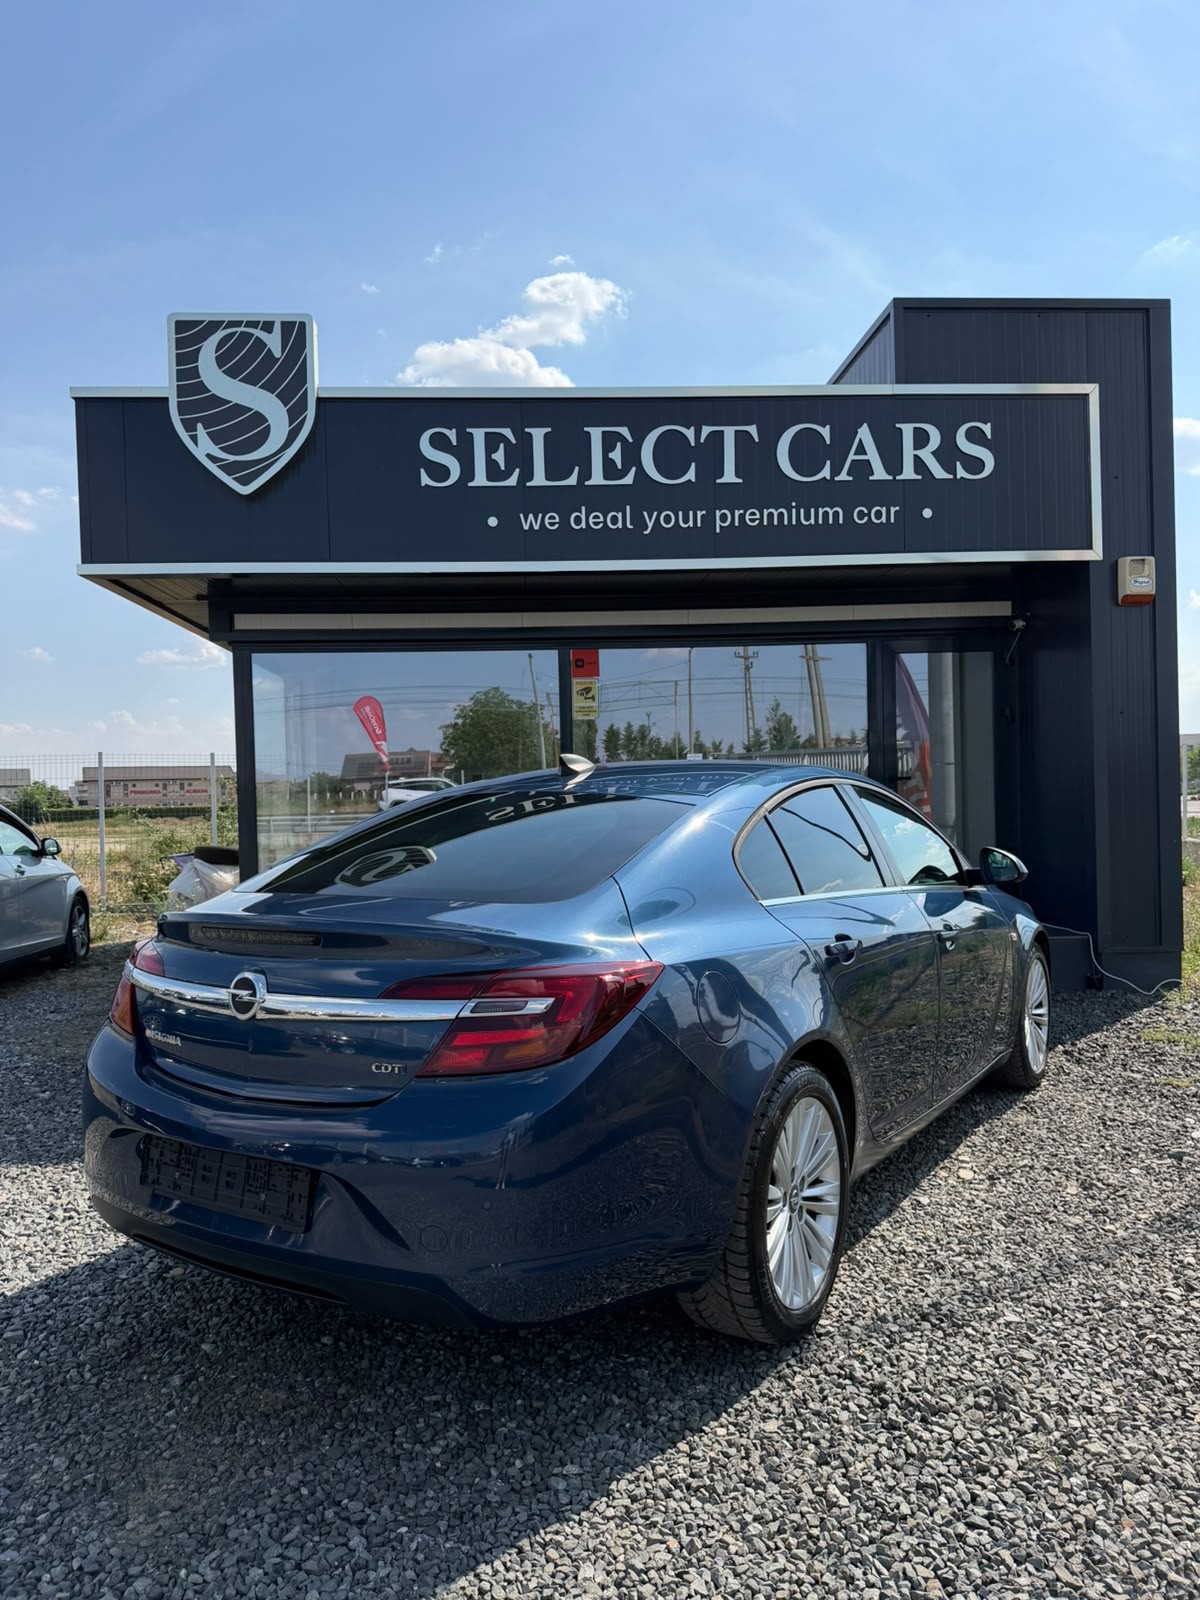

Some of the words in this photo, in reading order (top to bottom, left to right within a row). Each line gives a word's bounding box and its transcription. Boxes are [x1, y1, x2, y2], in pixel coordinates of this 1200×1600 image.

[196, 320, 290, 461] S
[419, 424, 759, 488] SELECT
[776, 422, 995, 483] CARS
[520, 512, 559, 531] we
[570, 505, 634, 530] deal
[643, 510, 707, 535] your
[715, 506, 844, 534] premium
[853, 506, 900, 525] car
